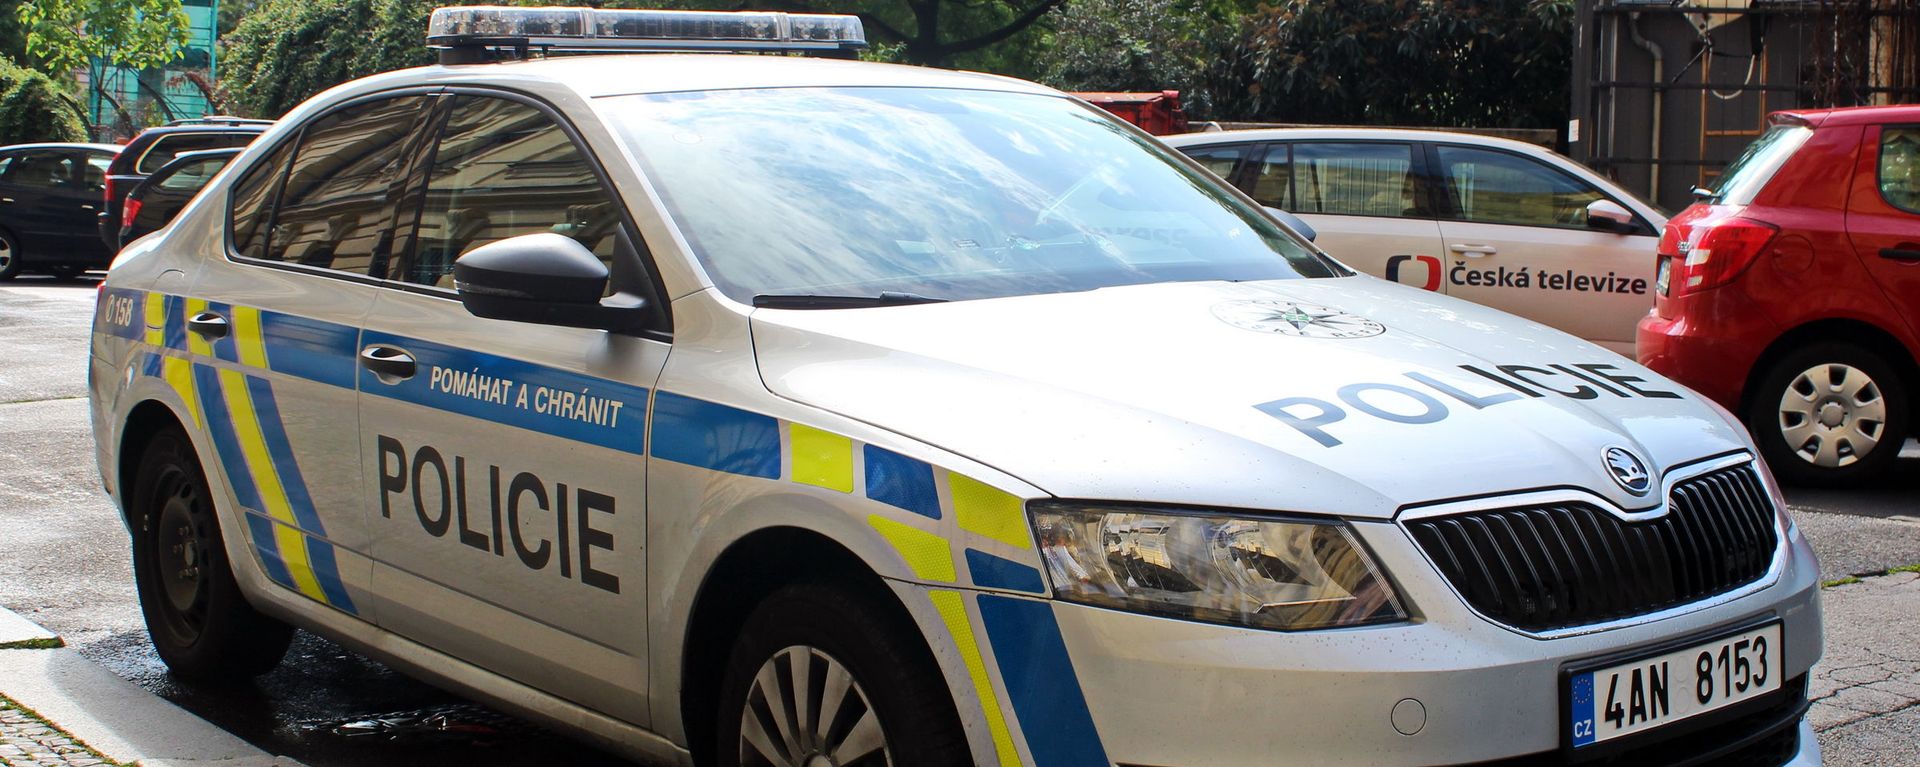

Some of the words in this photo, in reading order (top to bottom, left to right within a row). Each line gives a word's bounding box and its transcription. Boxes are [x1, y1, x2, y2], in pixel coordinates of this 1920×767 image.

[1450, 261, 1530, 289] Česká
[1537, 269, 1648, 295] televize
[114, 296, 134, 327] 158
[430, 366, 513, 405] POMÁHAT
[515, 383, 529, 410] A
[534, 388, 624, 428] CHRÁNIT
[1252, 363, 1685, 448] POLICIE
[378, 434, 620, 594] POLICIE
[1604, 661, 1669, 729] 4AN
[1696, 635, 1768, 704] 8153
[1574, 719, 1592, 738] CZ
